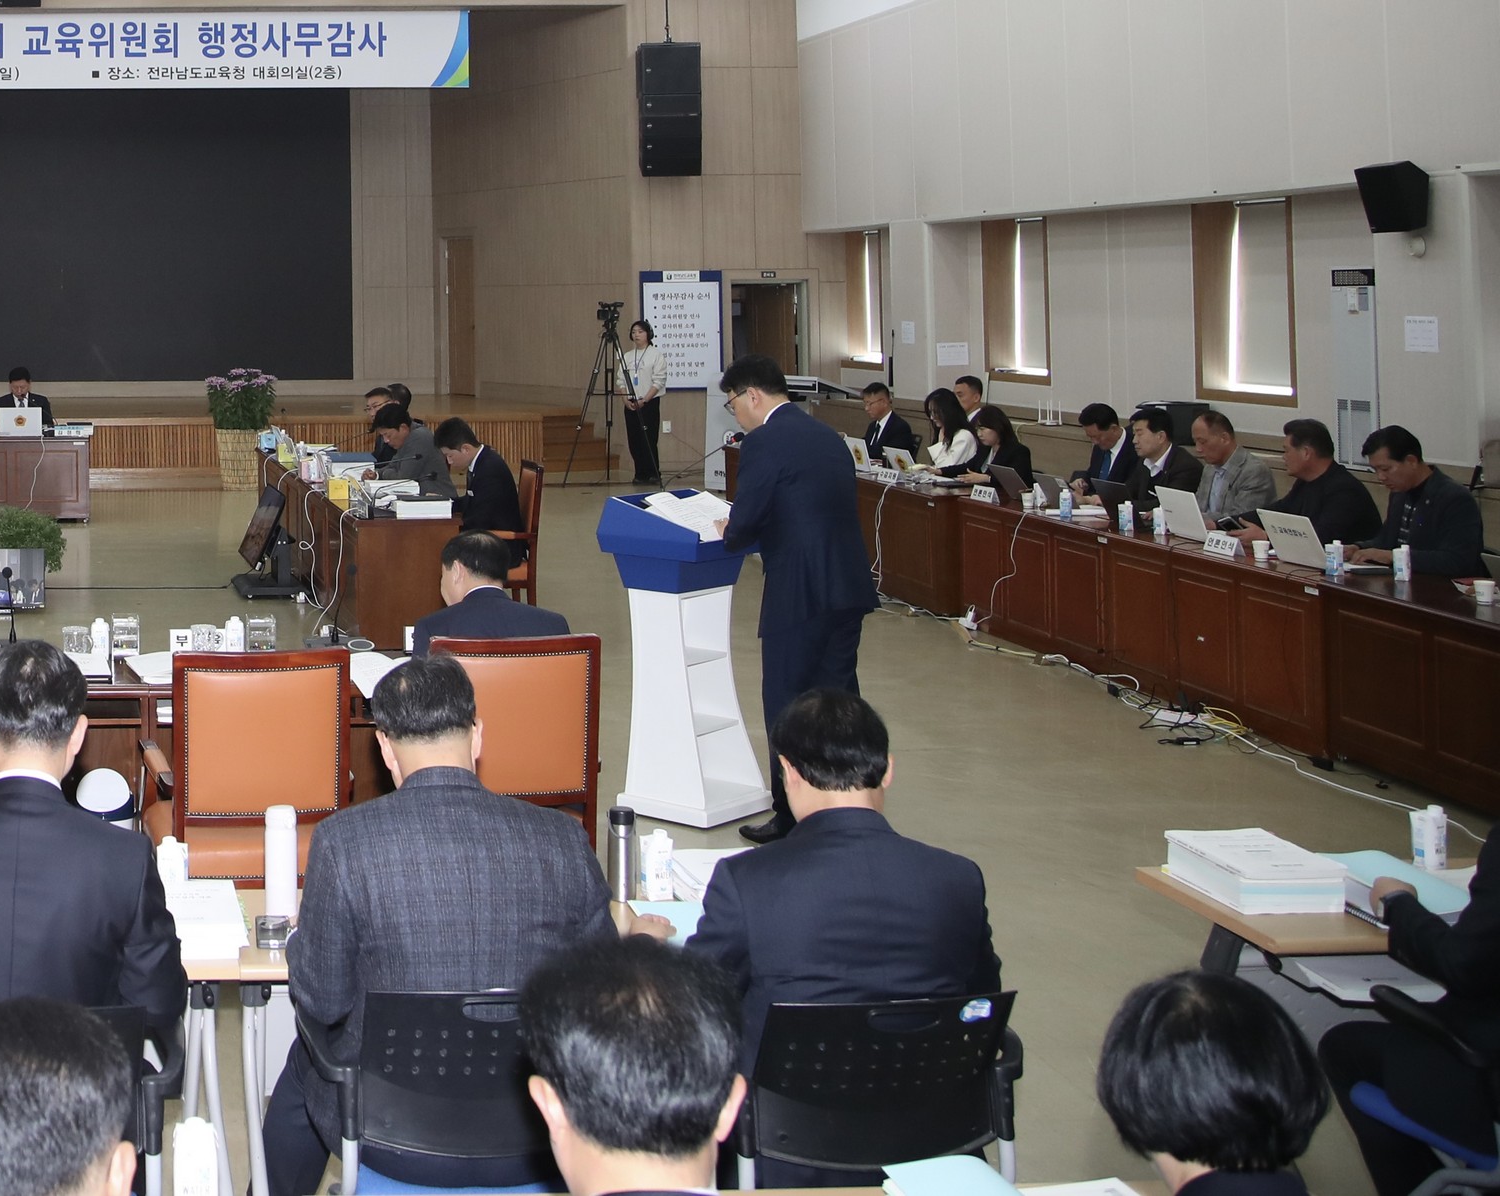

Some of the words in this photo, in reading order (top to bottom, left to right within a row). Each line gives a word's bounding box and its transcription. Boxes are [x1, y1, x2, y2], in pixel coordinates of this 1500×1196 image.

[22, 21, 179, 58] 교육위원회
[198, 21, 388, 58] 행정사무감사
[107, 66, 139, 80] 장소:
[147, 66, 246, 81] 전라남도교육청
[252, 65, 342, 81] 대회의실(2층)
[652, 292, 694, 300] 행정사무감사
[697, 292, 711, 300] 순서
[1207, 537, 1235, 553] 언론인석
